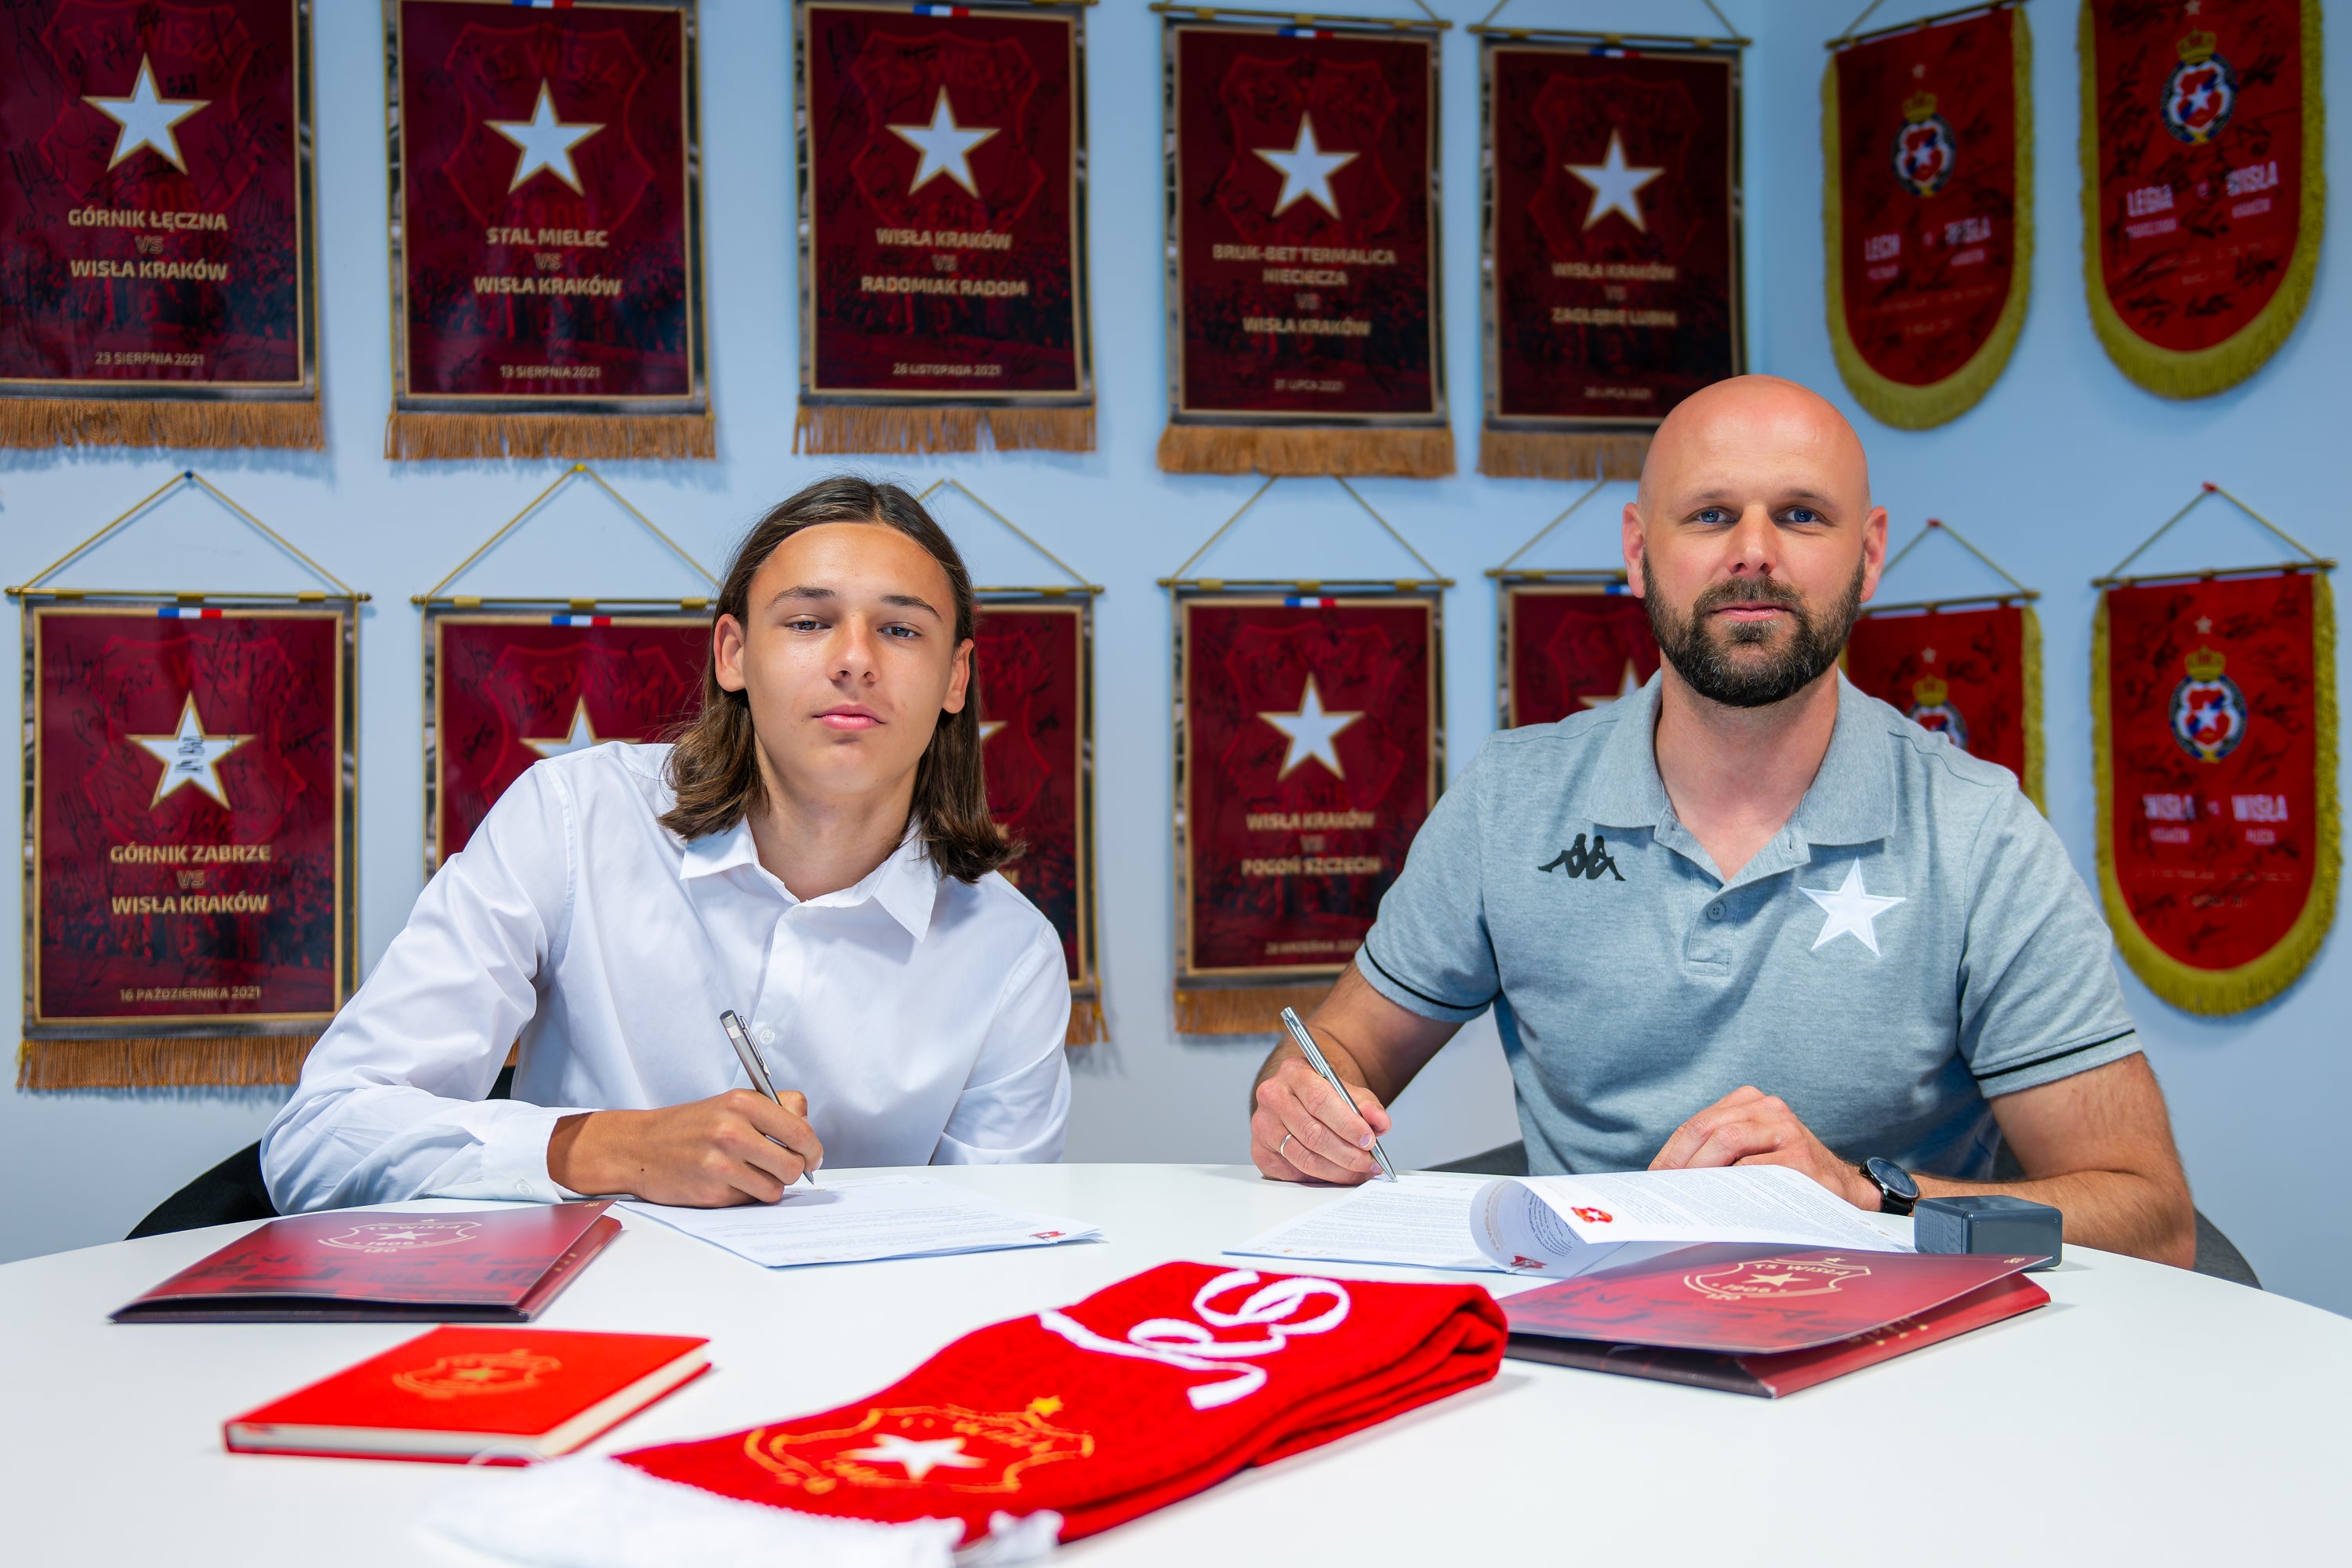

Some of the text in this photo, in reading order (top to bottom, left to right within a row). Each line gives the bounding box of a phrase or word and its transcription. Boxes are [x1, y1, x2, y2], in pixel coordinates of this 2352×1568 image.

[67, 205, 228, 232] GÓRNIK ŁĘCZNA
[135, 234, 163, 254] VS
[486, 227, 609, 248] STAL MIELEC
[876, 227, 1013, 250] WISŁA KRAKÓW
[71, 259, 228, 281] WISŁA KRAKÓW
[474, 274, 622, 296] WISŁA KRAKÓW
[861, 274, 1029, 297] RADOMIAK RADOM
[1242, 315, 1372, 336] WISŁA KRAKÓW
[95, 351, 205, 367] 23 SIERPNIA 2021
[500, 365, 601, 379] 13 SIERPNIA 2021
[110, 841, 271, 863] GÓRNIK ZABRZE
[176, 869, 205, 888] VS
[112, 891, 269, 914] WISŁA KRAKÓW
[119, 985, 261, 1002] 16 PAŹDZIERNIKA 2021
[1786, 1264, 1850, 1276] WISŁA
